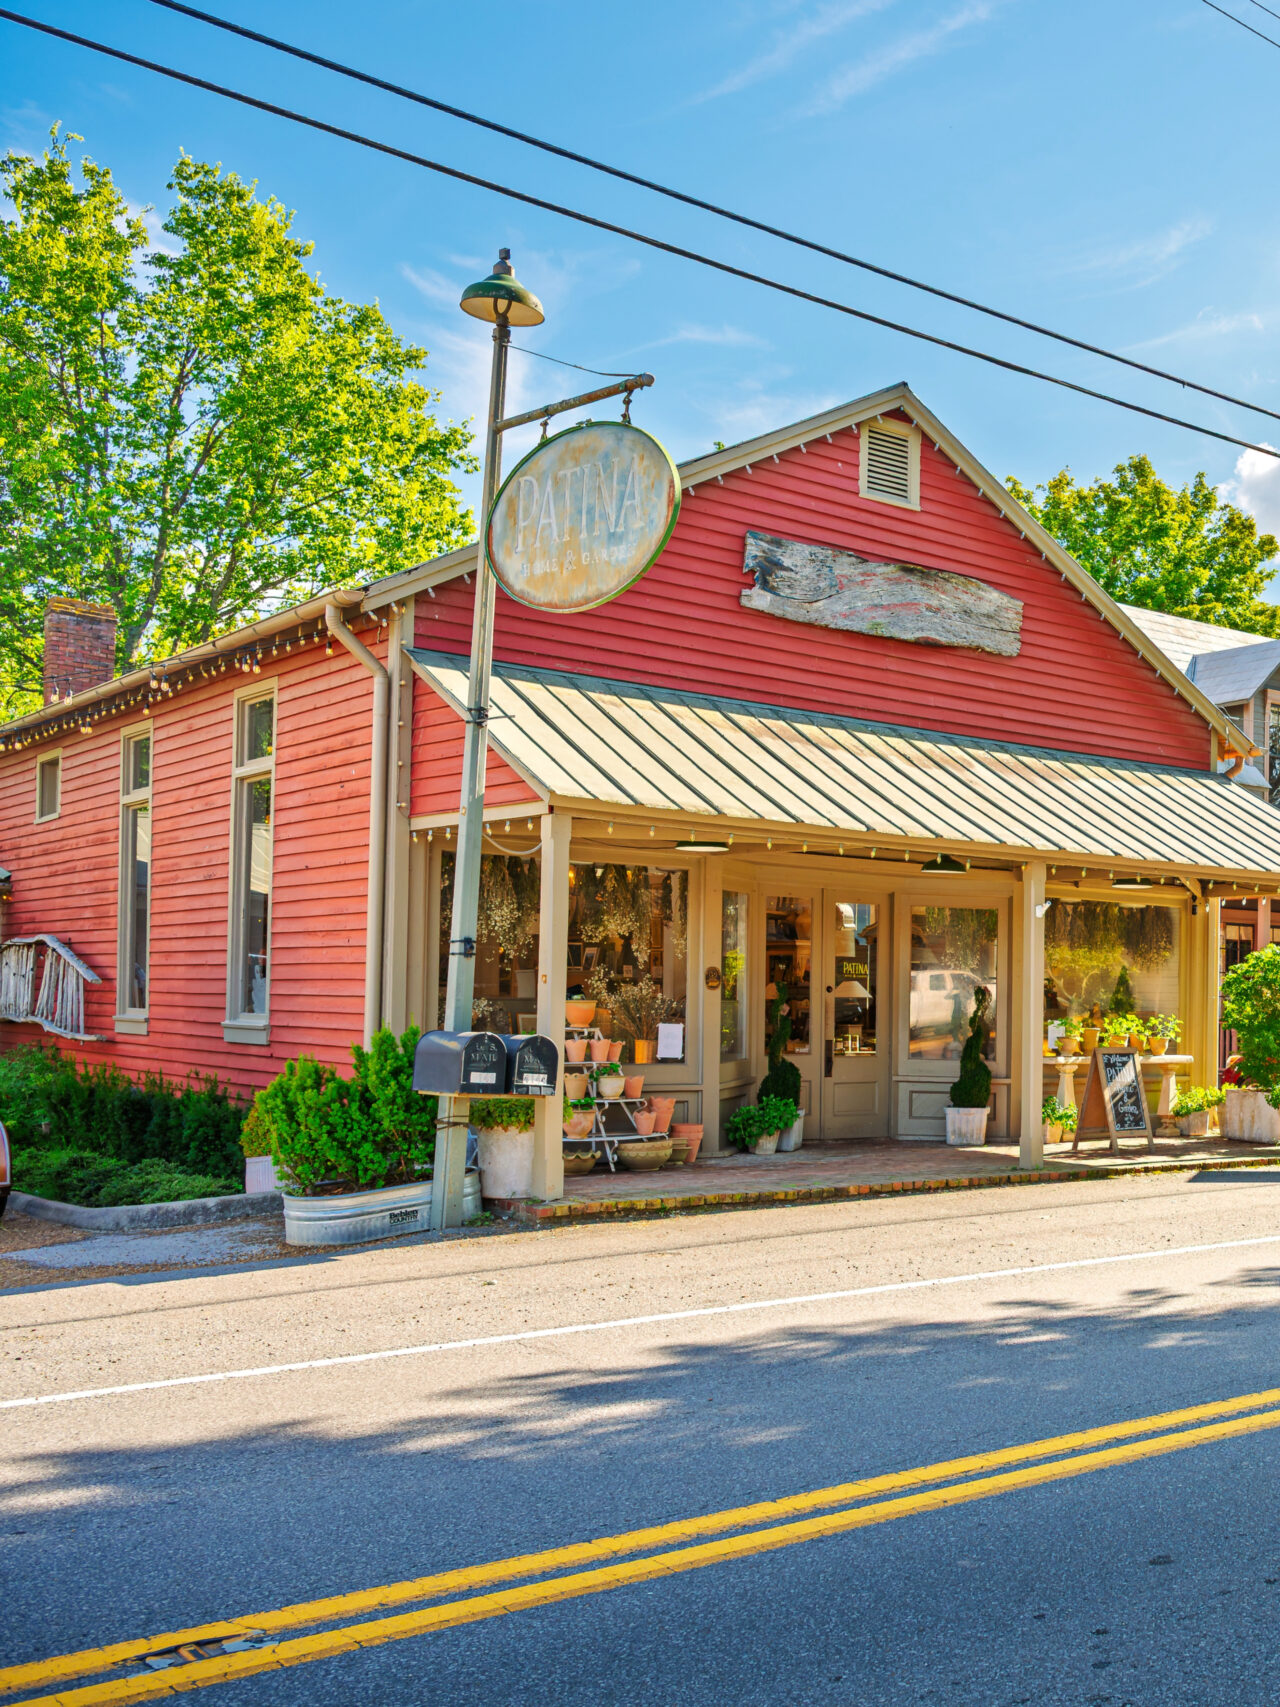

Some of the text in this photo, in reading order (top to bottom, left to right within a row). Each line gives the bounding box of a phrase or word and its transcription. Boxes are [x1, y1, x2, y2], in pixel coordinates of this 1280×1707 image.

[515, 454, 644, 553] PATINA
[520, 558, 558, 577] HOME
[566, 550, 576, 571] &
[843, 961, 869, 975] PATINA
[471, 1053, 497, 1062] MAIL
